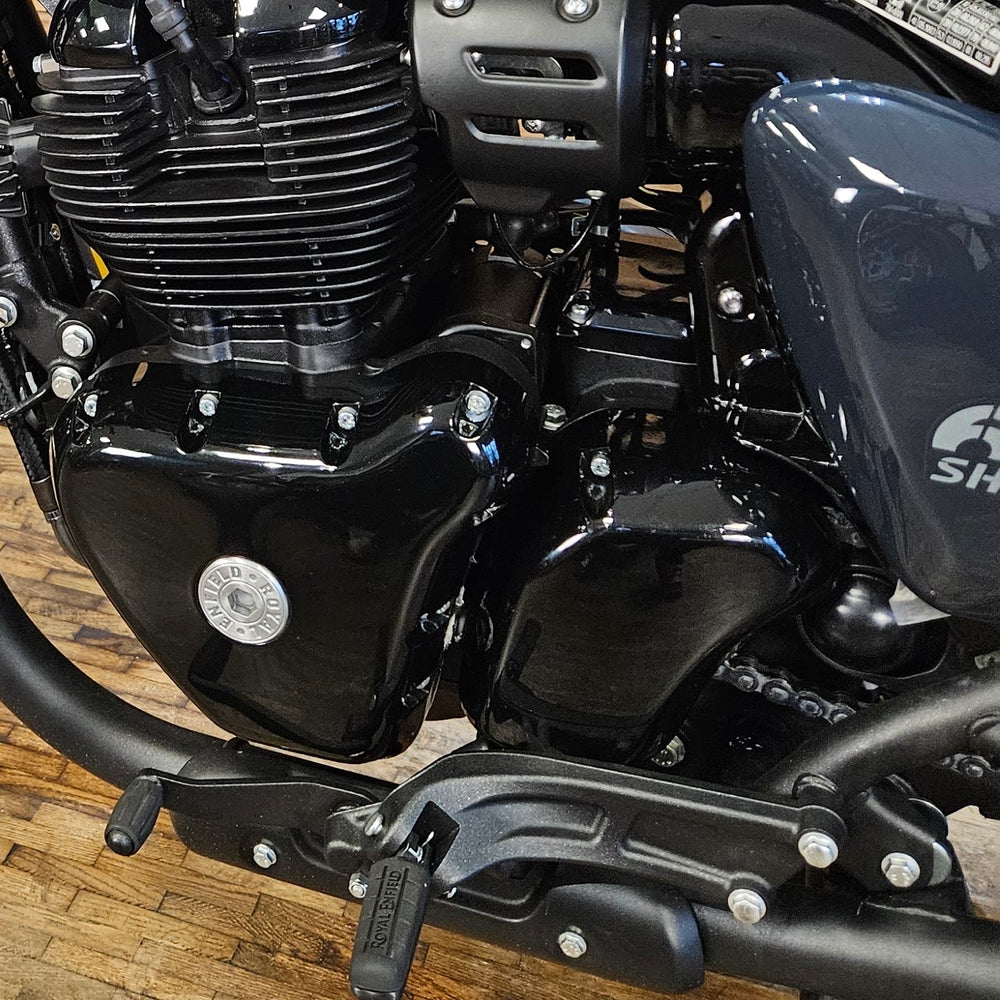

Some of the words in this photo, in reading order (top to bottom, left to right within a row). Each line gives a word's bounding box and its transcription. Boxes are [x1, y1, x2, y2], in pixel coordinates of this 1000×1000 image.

[204, 566, 242, 631] ENFIELD
[248, 583, 282, 640] ROYAL
[378, 869, 403, 914] ENFIELD
[370, 910, 392, 950] ROYAL
